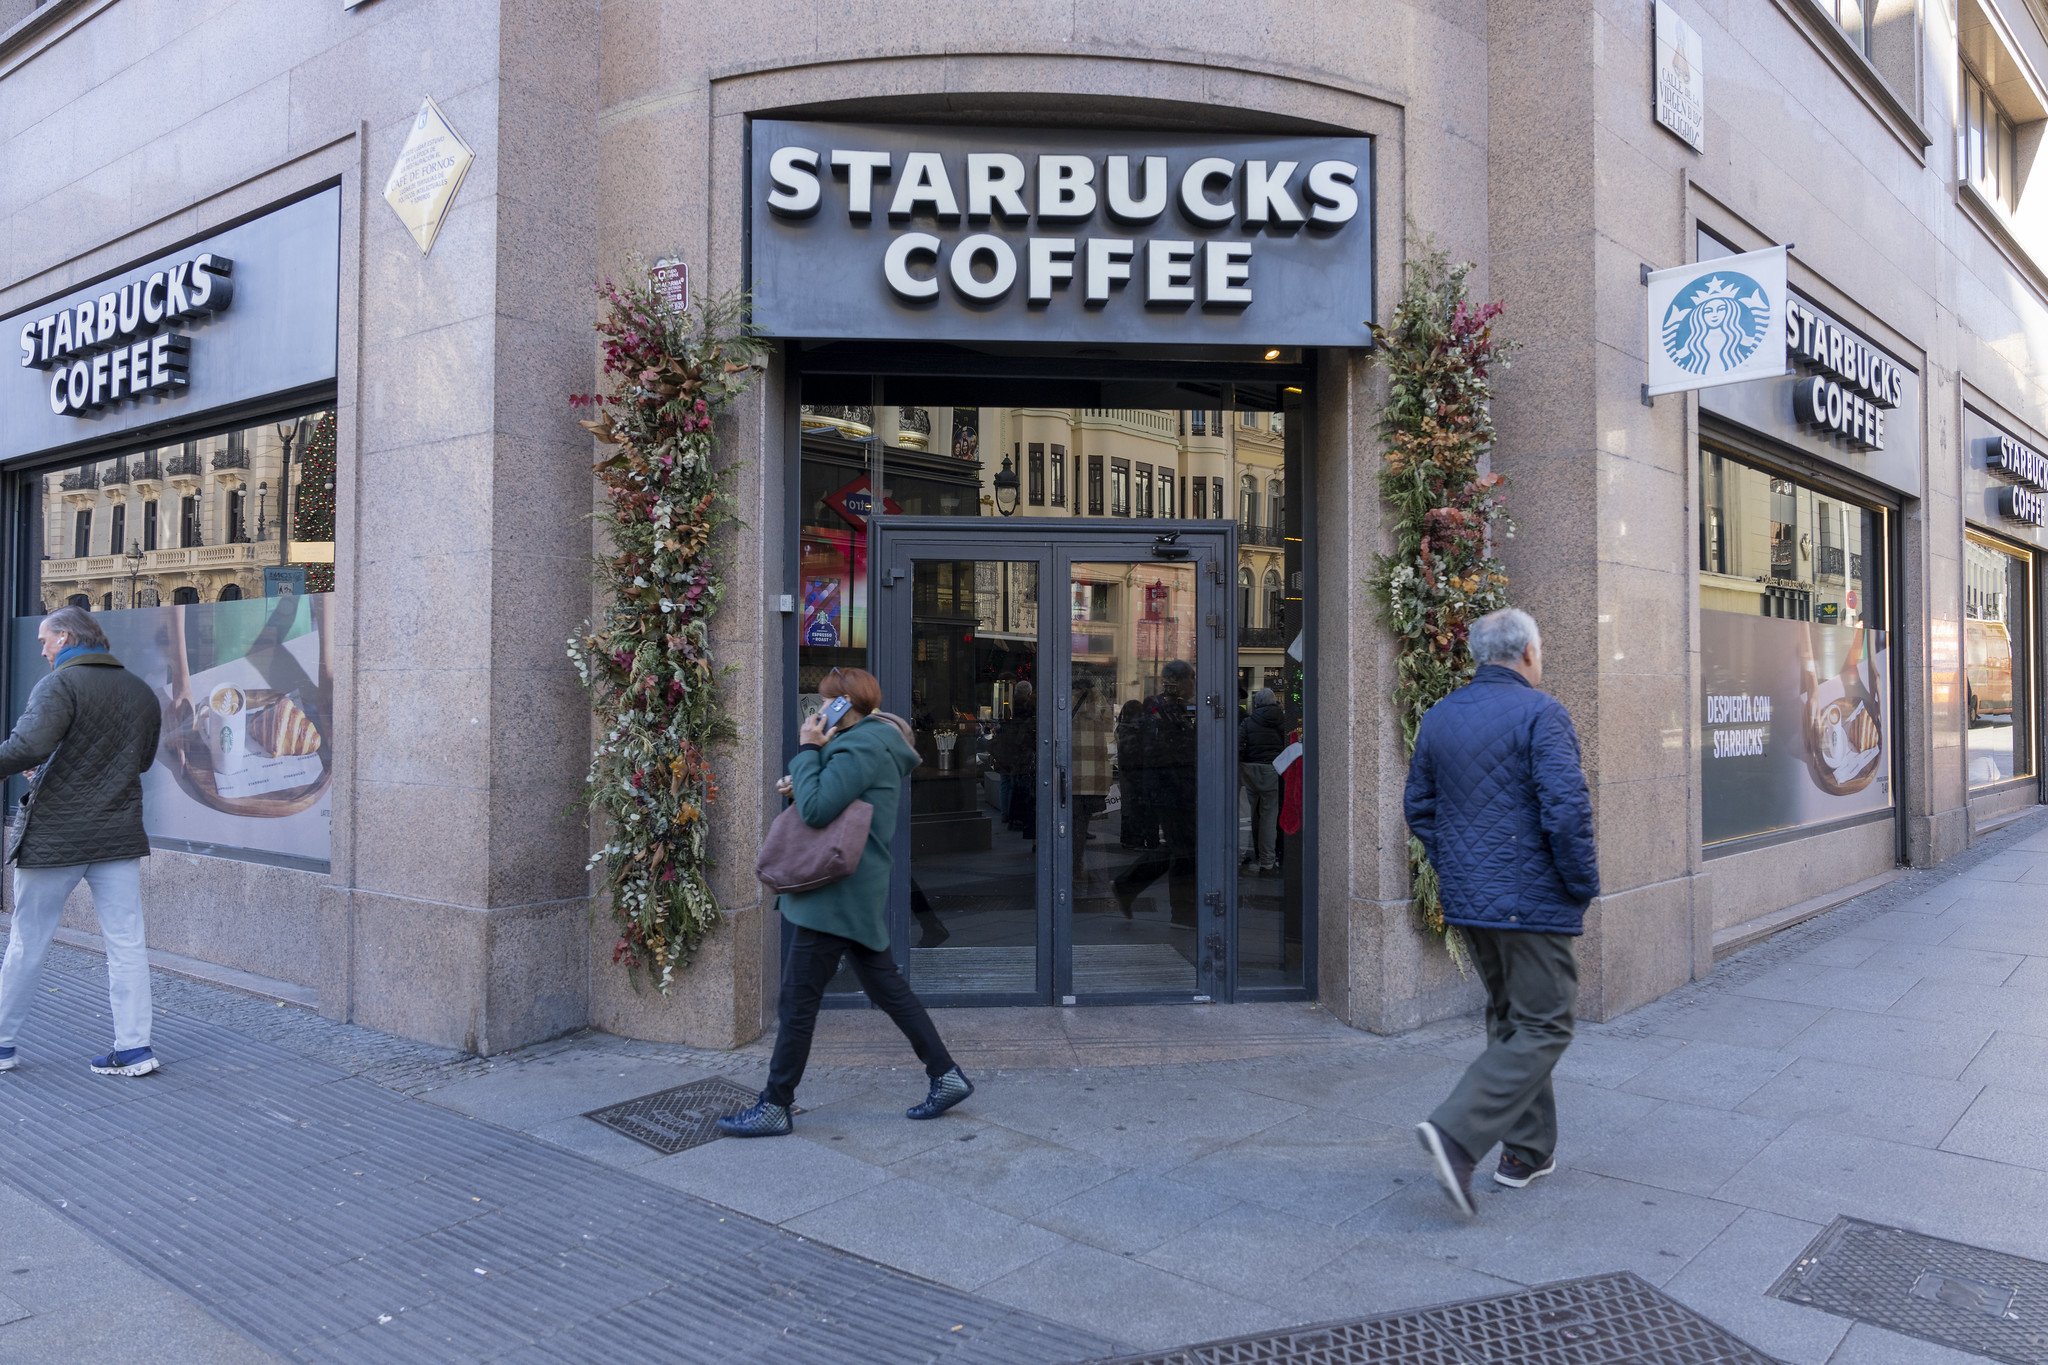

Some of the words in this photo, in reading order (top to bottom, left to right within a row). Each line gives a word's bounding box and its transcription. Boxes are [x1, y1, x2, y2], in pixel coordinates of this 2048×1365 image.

[1660, 80, 1686, 117] VIRGEN
[1661, 67, 1683, 94] CALLE
[1662, 105, 1700, 146] PELIGROS
[409, 168, 419, 182] DE
[421, 155, 455, 177] FORNOS
[766, 146, 1359, 225] STARBUCKS
[884, 232, 1252, 304] COFFEE
[20, 253, 214, 368] STARBUCKS
[50, 332, 170, 415] COFFEE
[1786, 299, 1903, 409] STARBUCKS
[1812, 374, 1884, 450] COFFEE
[2001, 436, 2048, 491] STARBUCK
[2012, 485, 2045, 527] COFFEE
[1707, 695, 1752, 723] DESPIERTA
[1753, 695, 1770, 722] CON
